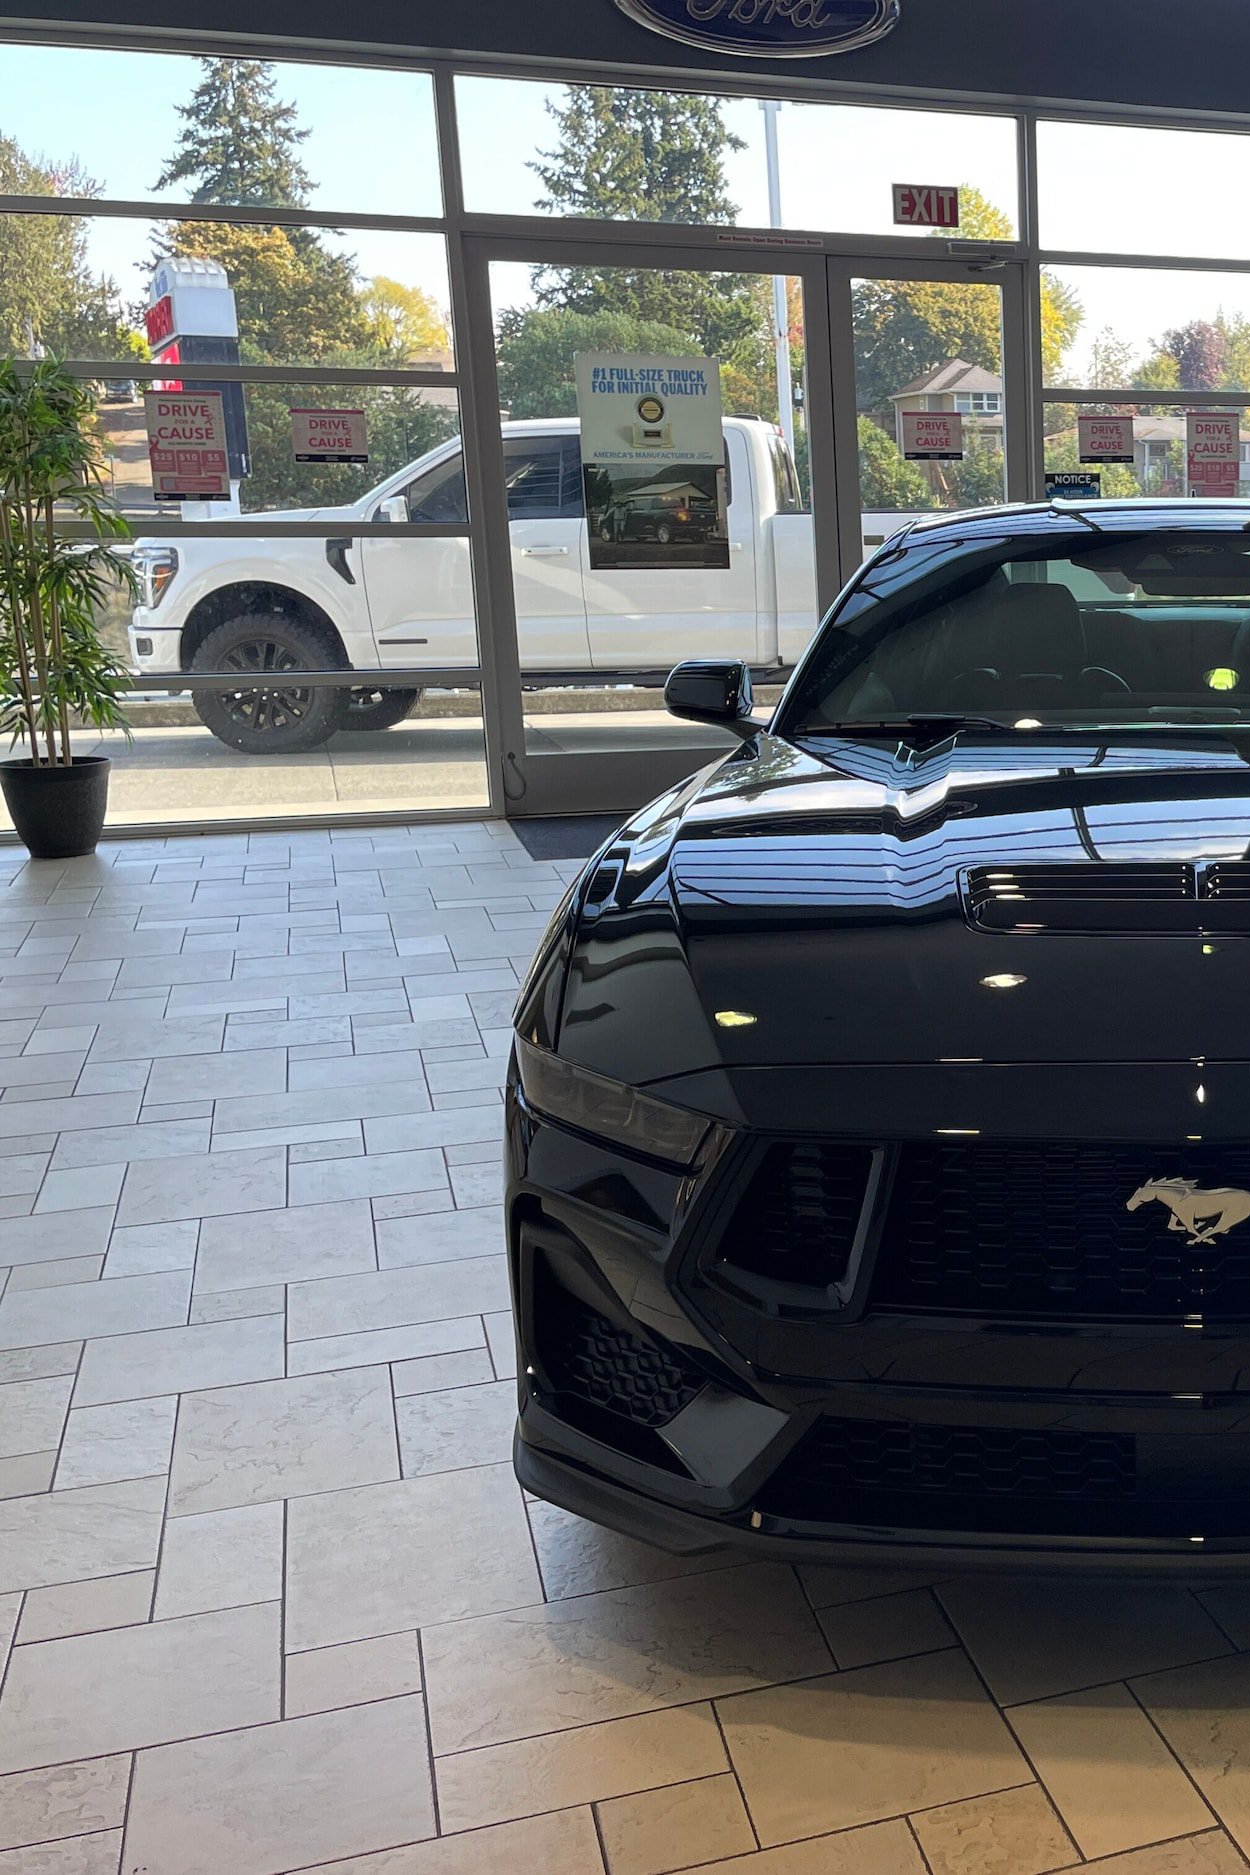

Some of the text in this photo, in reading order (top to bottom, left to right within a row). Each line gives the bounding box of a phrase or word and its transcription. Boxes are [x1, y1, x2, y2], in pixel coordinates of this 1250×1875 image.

[895, 187, 954, 223] EXIT
[592, 368, 704, 383] #1 FULL-SIZE TRUCK
[592, 381, 707, 397] FOR INITIAL QUALITY
[157, 404, 209, 417] DRIVE
[309, 420, 349, 430] DRIVE
[916, 421, 948, 430] DRIVE
[1091, 425, 1121, 434] DRIVE
[1195, 424, 1231, 434] DRIVE
[157, 427, 215, 440] CAUSE
[308, 438, 352, 448] CAUSE
[916, 437, 951, 447] CAUSE
[1090, 441, 1123, 450] CAUSE
[1194, 443, 1233, 453] CAUSE
[154, 452, 220, 462] $25 $10 $5
[1054, 474, 1092, 484] NOTICE
